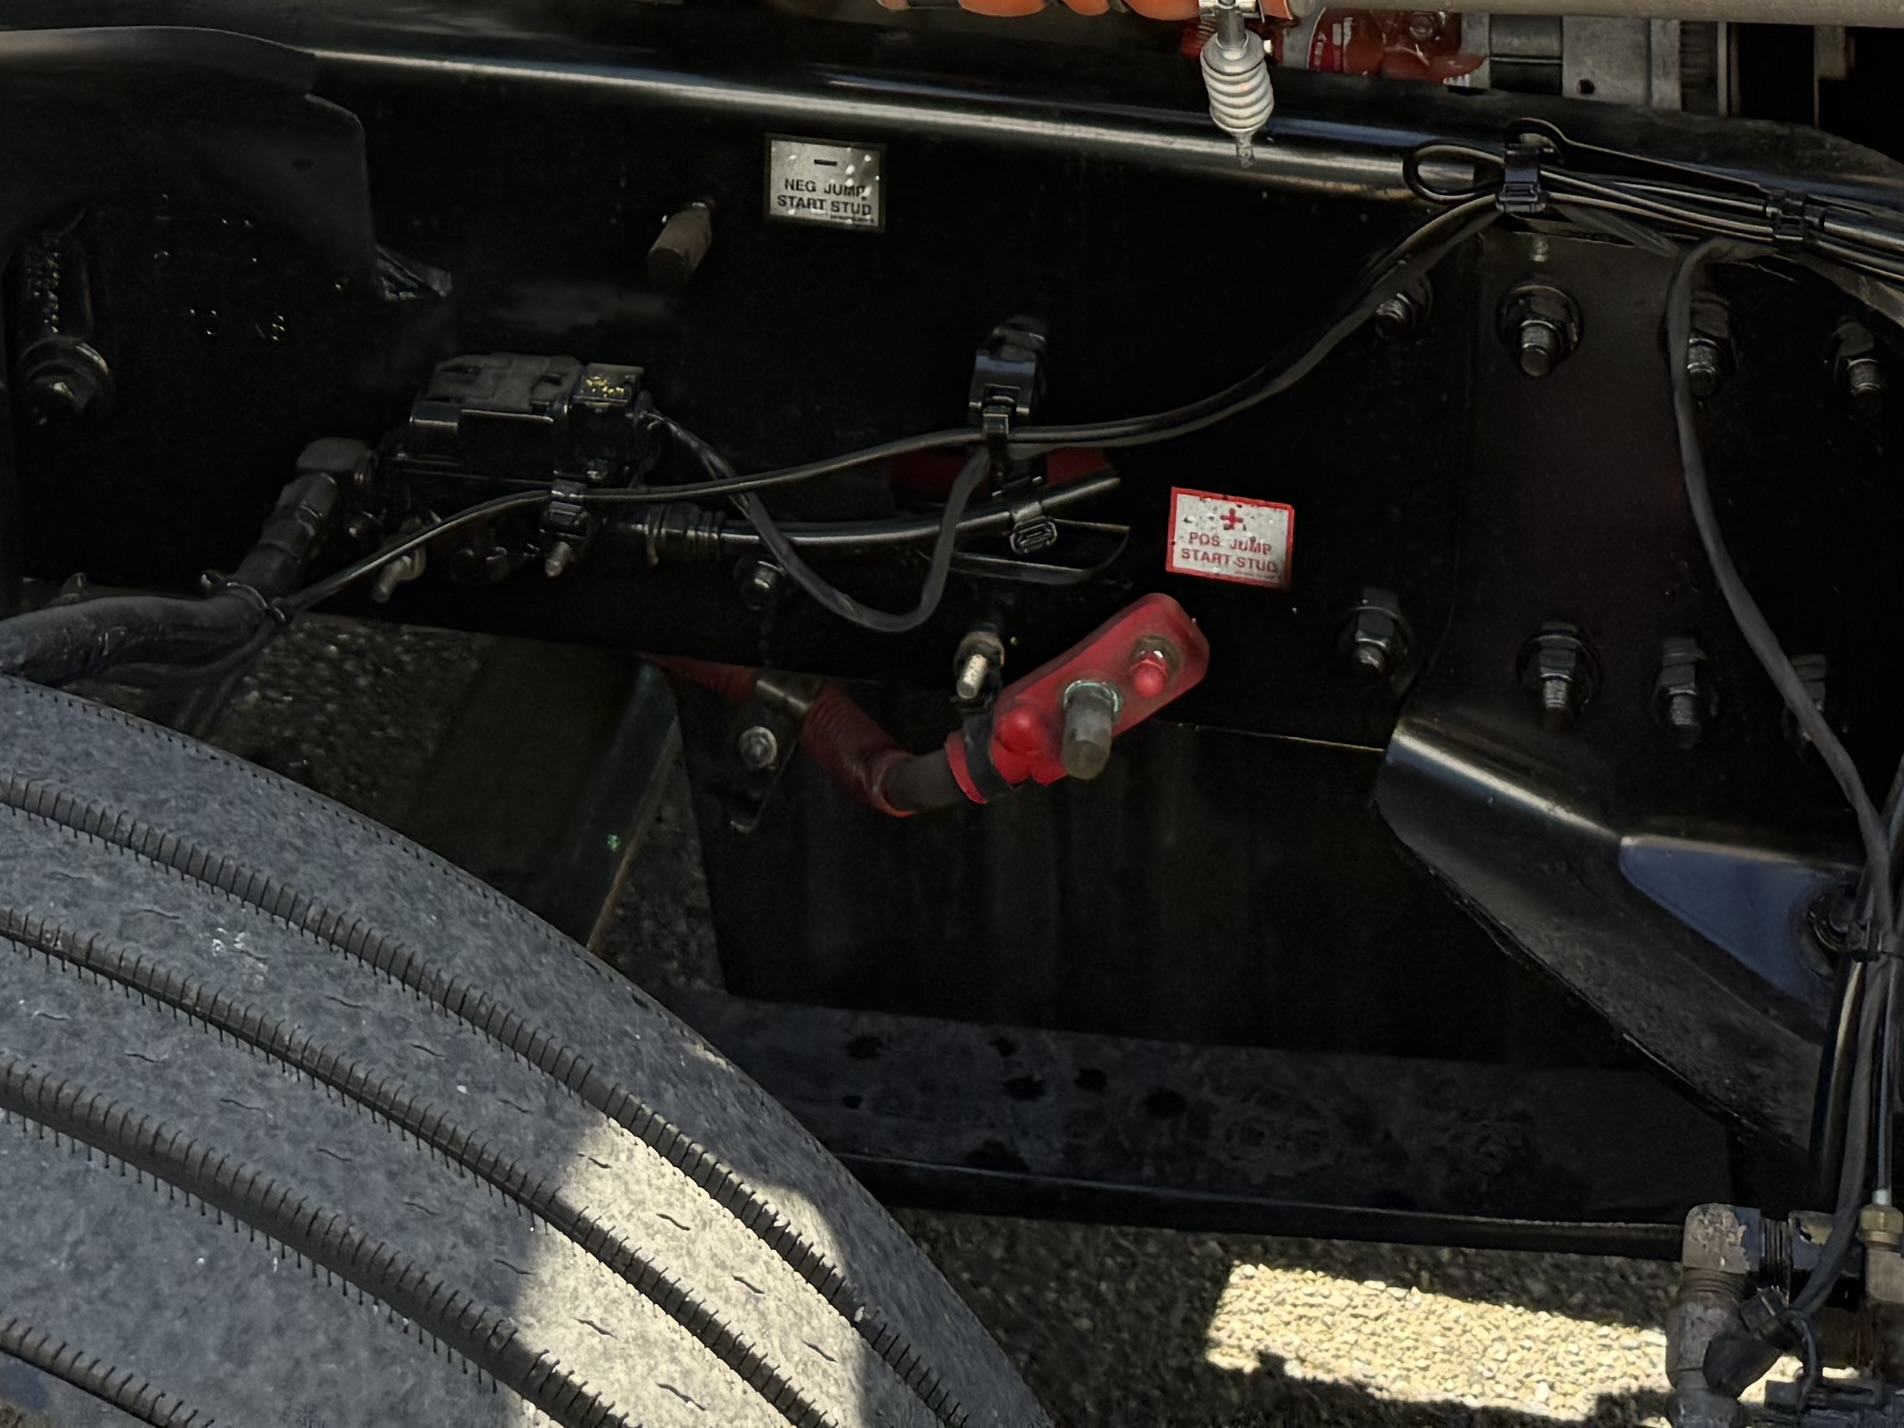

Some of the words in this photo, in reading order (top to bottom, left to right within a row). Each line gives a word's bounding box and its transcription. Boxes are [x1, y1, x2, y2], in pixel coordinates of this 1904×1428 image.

[784, 178, 816, 193] NEG
[824, 183, 867, 198] JUMP
[777, 194, 827, 210] START
[831, 200, 872, 216] STUD
[1188, 531, 1221, 547] POS
[1230, 540, 1273, 556] JUMP
[1181, 548, 1232, 566] START
[1236, 556, 1279, 573] STUD
